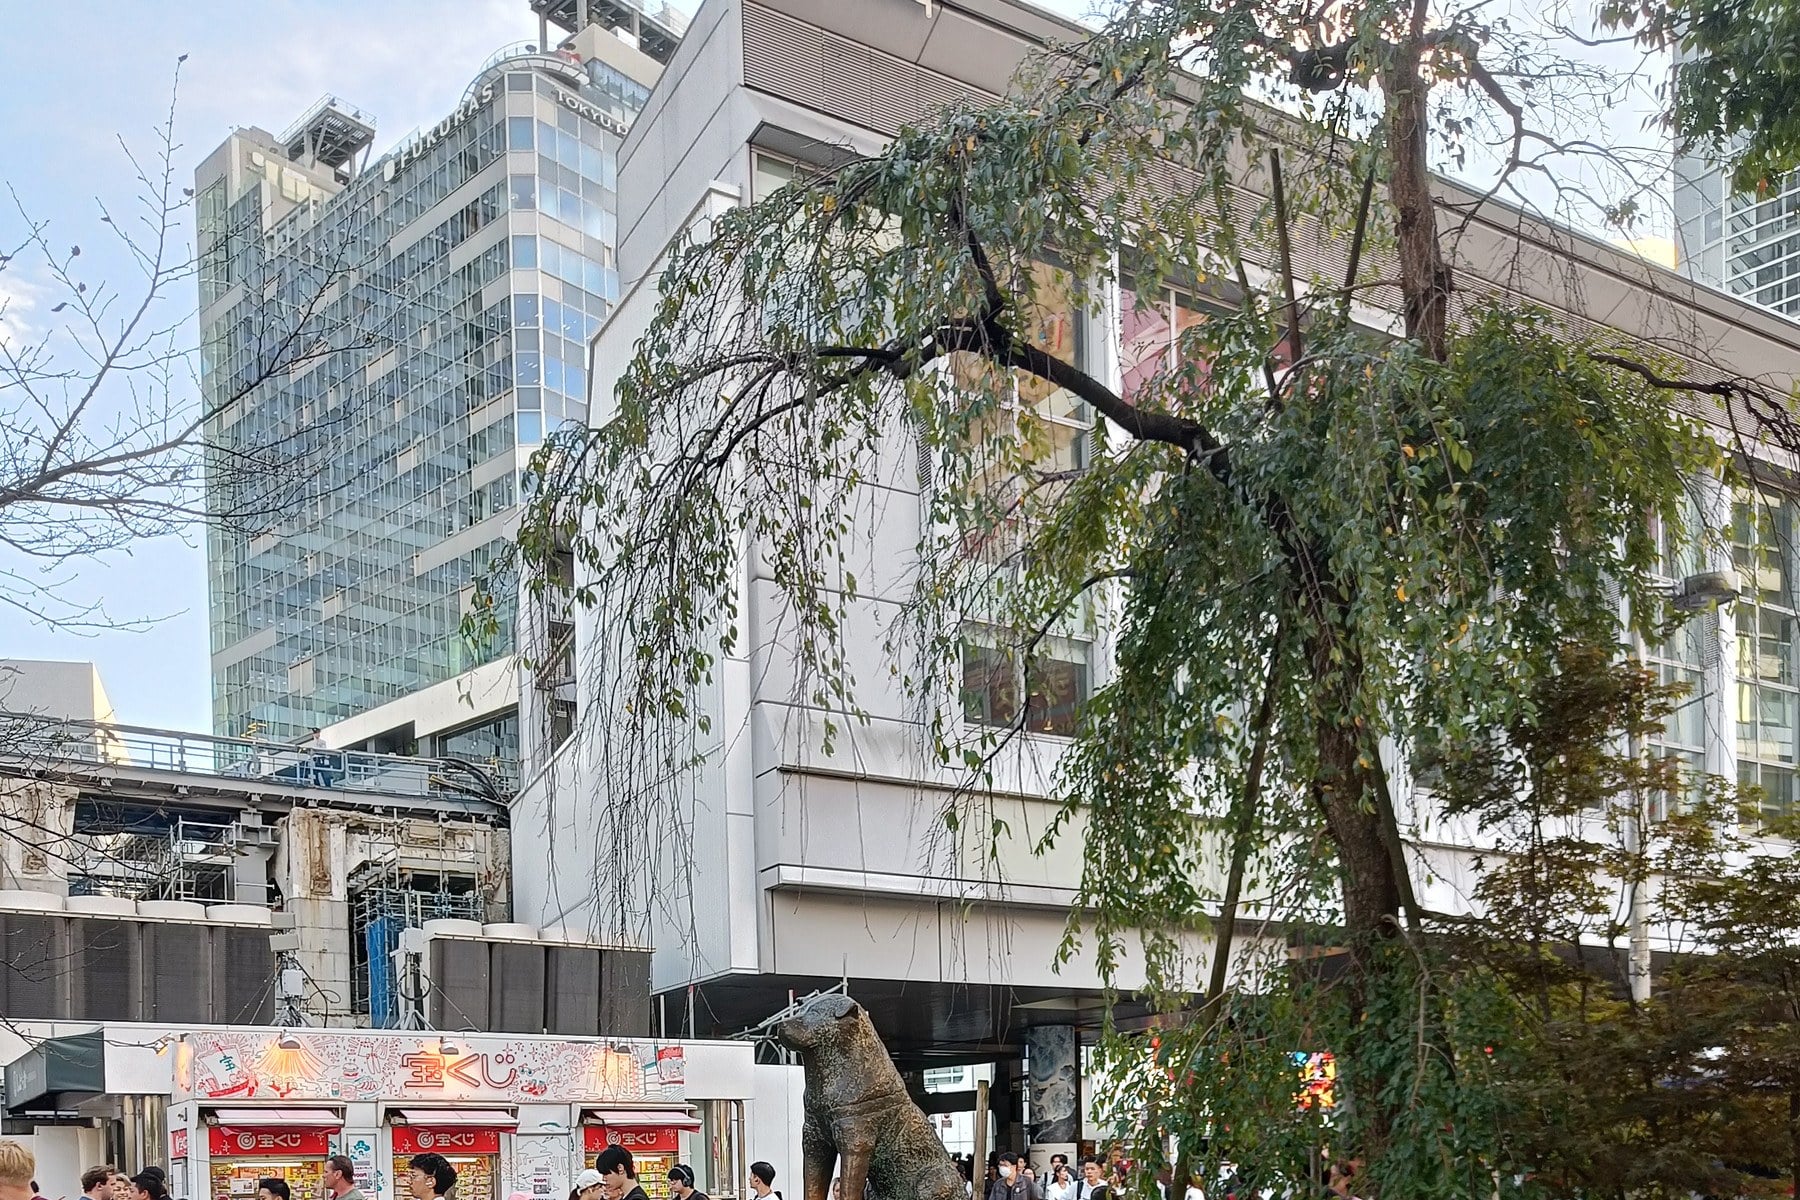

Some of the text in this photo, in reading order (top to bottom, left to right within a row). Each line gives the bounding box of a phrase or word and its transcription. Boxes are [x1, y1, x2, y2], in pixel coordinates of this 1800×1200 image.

[556, 88, 611, 127] TOKYU
[400, 83, 494, 169] FUKURAS
[401, 1051, 517, 1088] 宝くじ
[258, 1133, 302, 1148] 宝くじ
[435, 1133, 475, 1147] 宝くじ
[622, 1132, 657, 1145] 宝くじ
